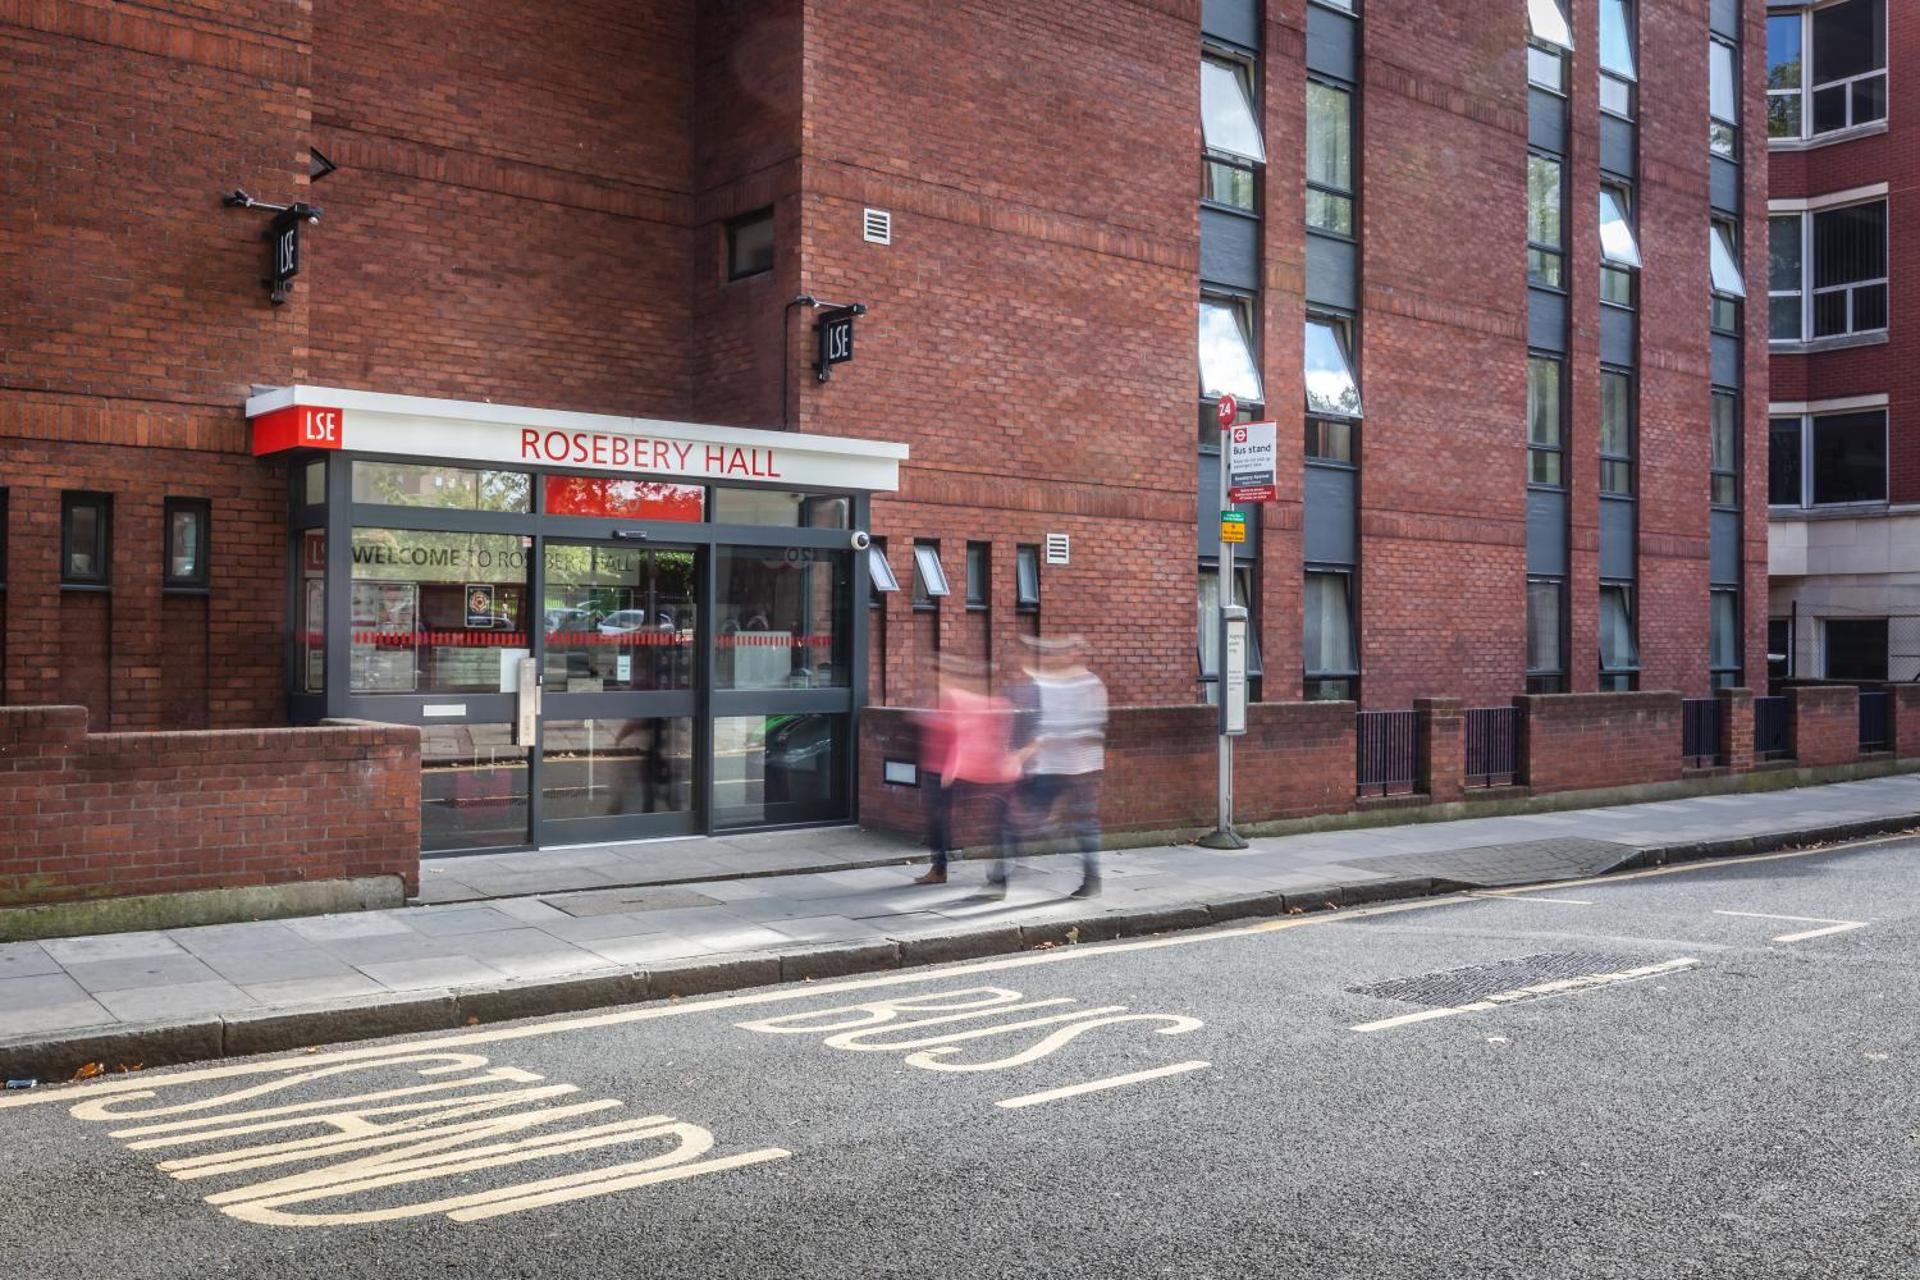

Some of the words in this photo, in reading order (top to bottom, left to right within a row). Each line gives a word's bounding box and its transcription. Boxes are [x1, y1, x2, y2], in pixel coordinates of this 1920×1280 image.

[281, 229, 294, 274] LSE
[830, 325, 848, 359] LSE
[306, 411, 335, 440] LSE
[521, 428, 693, 470] ROSEBERY
[705, 445, 781, 477] HALL
[1233, 446, 1246, 456] Bus
[1248, 444, 1271, 454] stand
[351, 546, 460, 567] WELCOME
[467, 549, 492, 569] TO
[733, 986, 1205, 1072] BUS
[69, 1052, 715, 1227] STAND
